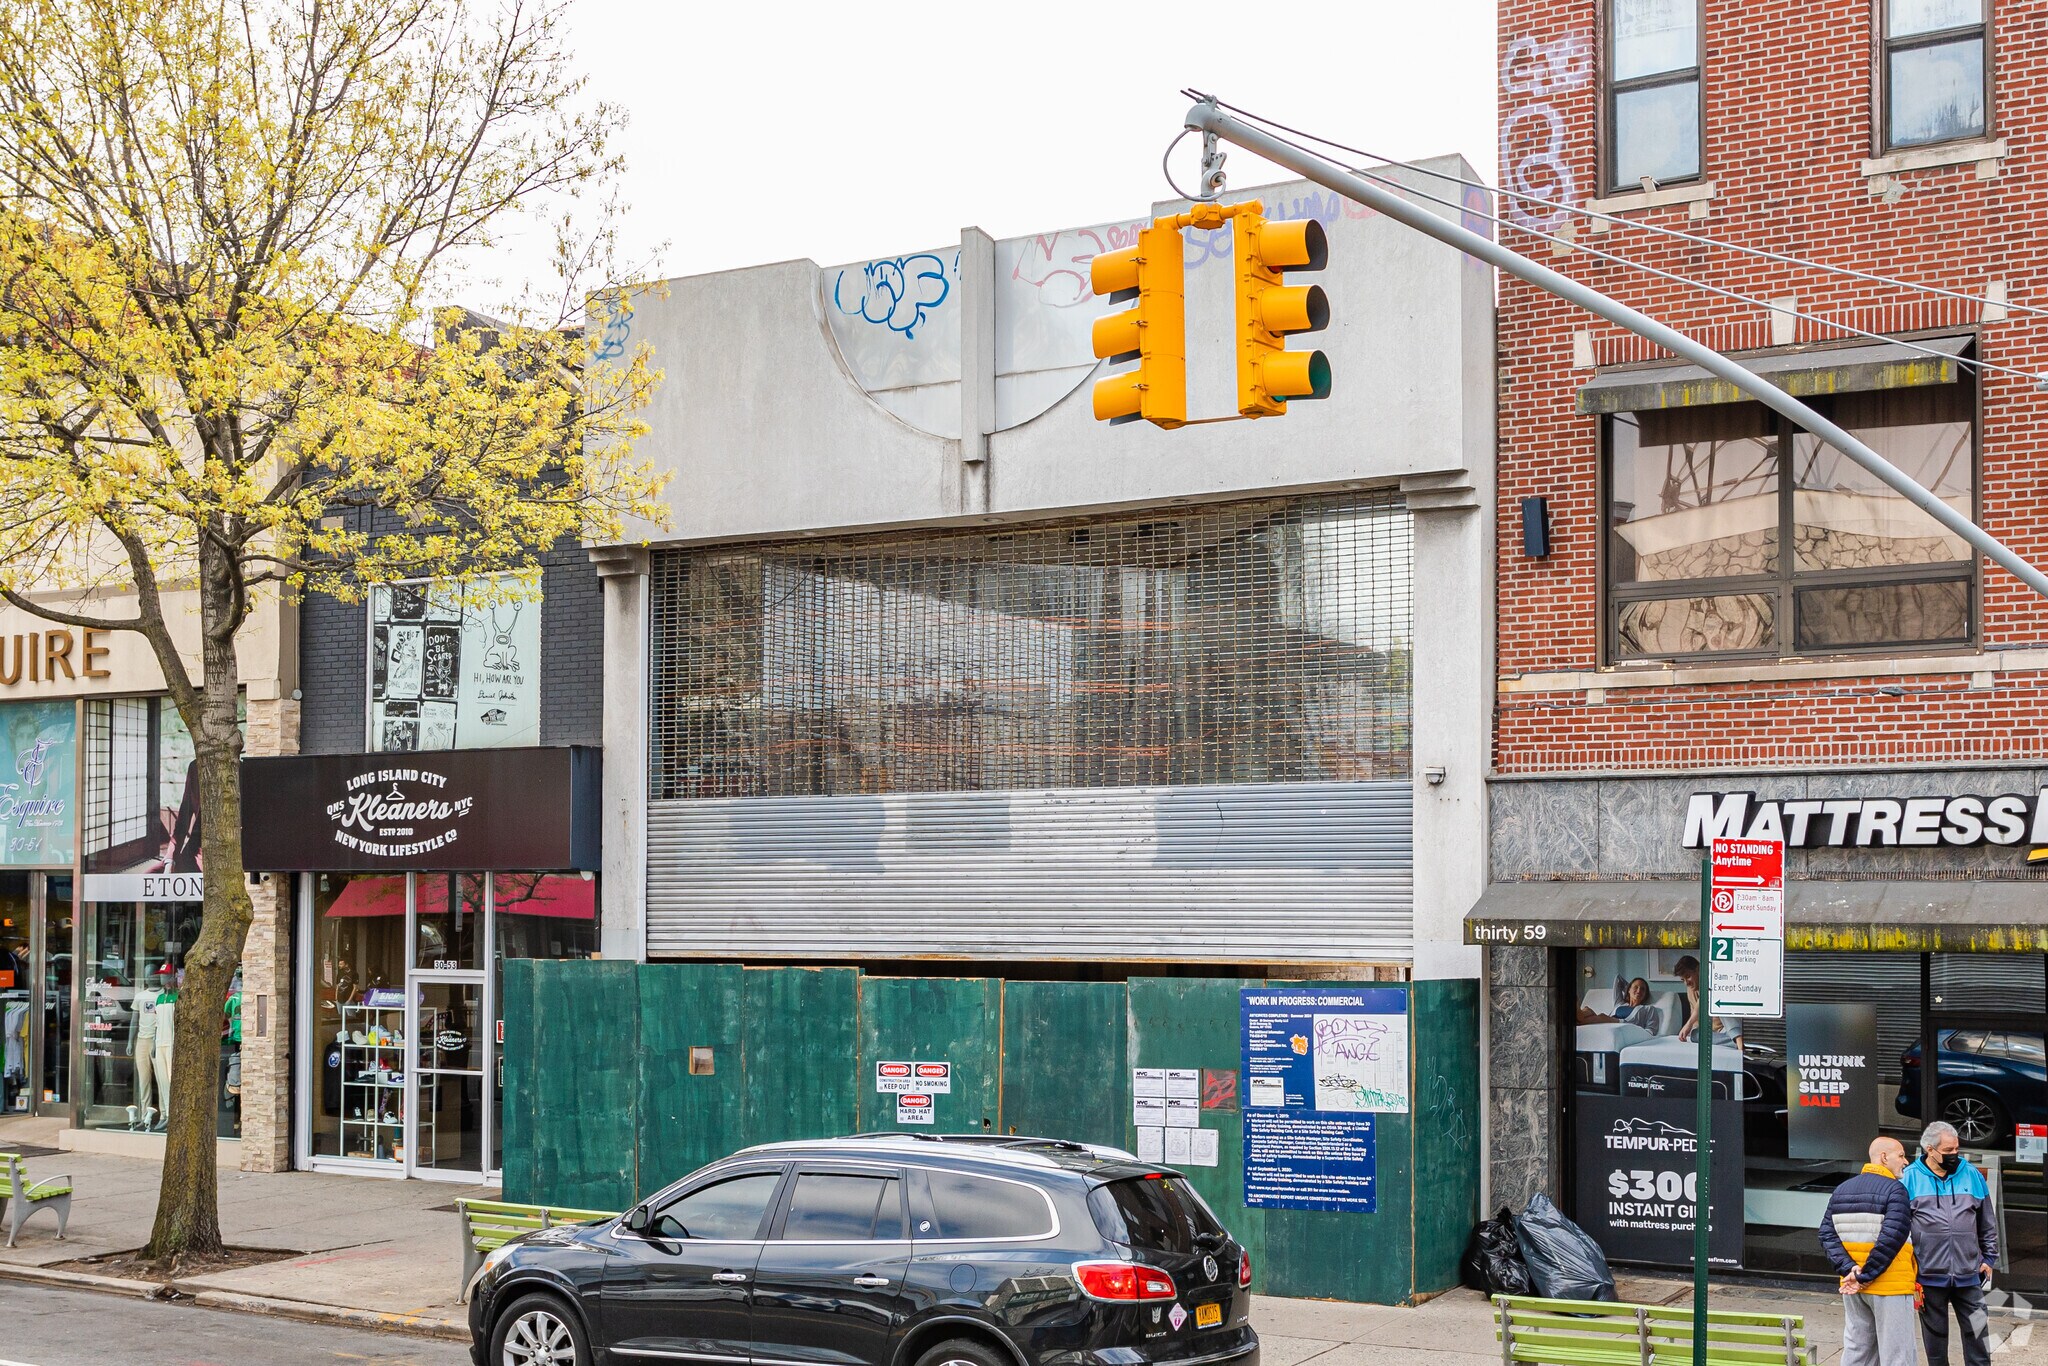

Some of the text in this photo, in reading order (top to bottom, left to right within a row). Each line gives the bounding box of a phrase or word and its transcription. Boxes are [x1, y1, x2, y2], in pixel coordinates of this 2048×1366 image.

[434, 645, 445, 653] BE
[486, 673, 501, 684] HOW
[502, 674, 511, 685] ARE
[513, 675, 524, 685] YOU
[346, 769, 447, 791] LONG ISLAND CITY
[0, 783, 65, 829] Esquire
[327, 792, 473, 832] QNS Kleaners NYC
[1683, 794, 2027, 847] MATTRESS
[396, 827, 414, 836] 2010
[335, 830, 358, 849] NEW
[359, 840, 388, 856] YORK
[389, 835, 445, 857] LIFESTYLE
[1715, 843, 1774, 855] NO STANDING
[1715, 856, 1752, 867] Anytime
[1737, 904, 1755, 912] Except
[1475, 925, 1546, 943] thirty 59
[1716, 939, 1728, 960] 2
[434, 961, 457, 970] 30-53
[1714, 984, 1762, 993] Except Sunday
[1270, 996, 1277, 1005] IN
[1278, 996, 1317, 1005] PROGRESS:
[1317, 997, 1364, 1006] COMMERCIAL
[1798, 1055, 1865, 1067] UNJUNK
[1798, 1068, 1842, 1080] YOUR
[1798, 1081, 1849, 1093] SLEEP
[1799, 1094, 1840, 1107] SALE
[1609, 1202, 1713, 1219] INSTANT GIT
[1609, 1219, 1713, 1232] with mattress purche
